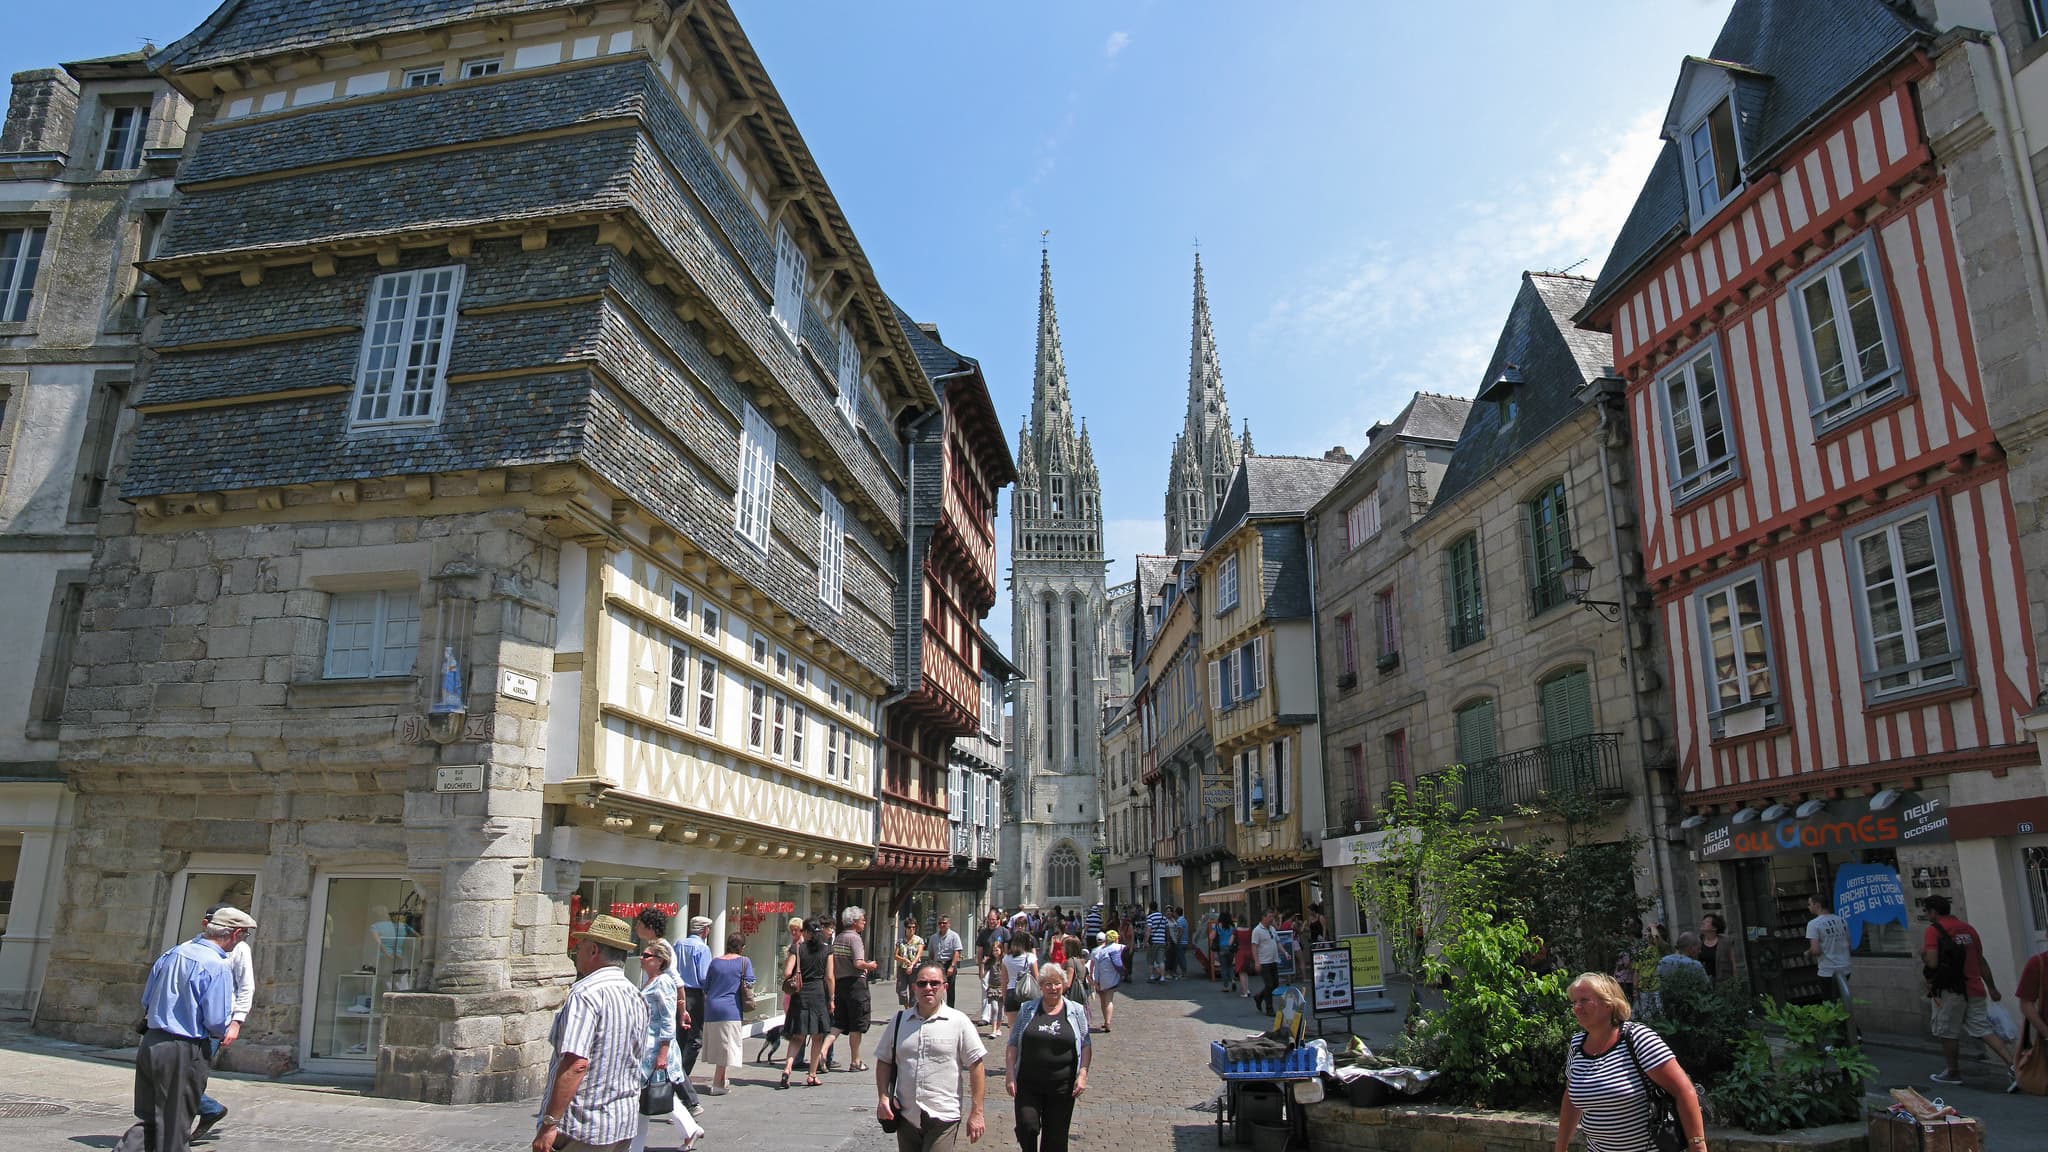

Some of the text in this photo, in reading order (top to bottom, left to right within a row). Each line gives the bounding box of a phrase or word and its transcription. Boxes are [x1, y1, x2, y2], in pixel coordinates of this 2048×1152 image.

[1903, 799, 1940, 821] NEUF
[1919, 815, 1929, 824] ET
[1903, 817, 1949, 839] OCCASION
[1840, 886, 1869, 905] RACHAT
[1870, 884, 1881, 895] EN
[1838, 906, 1851, 921] 02
[1853, 900, 1866, 914] 98
[1868, 896, 1882, 909] 64
